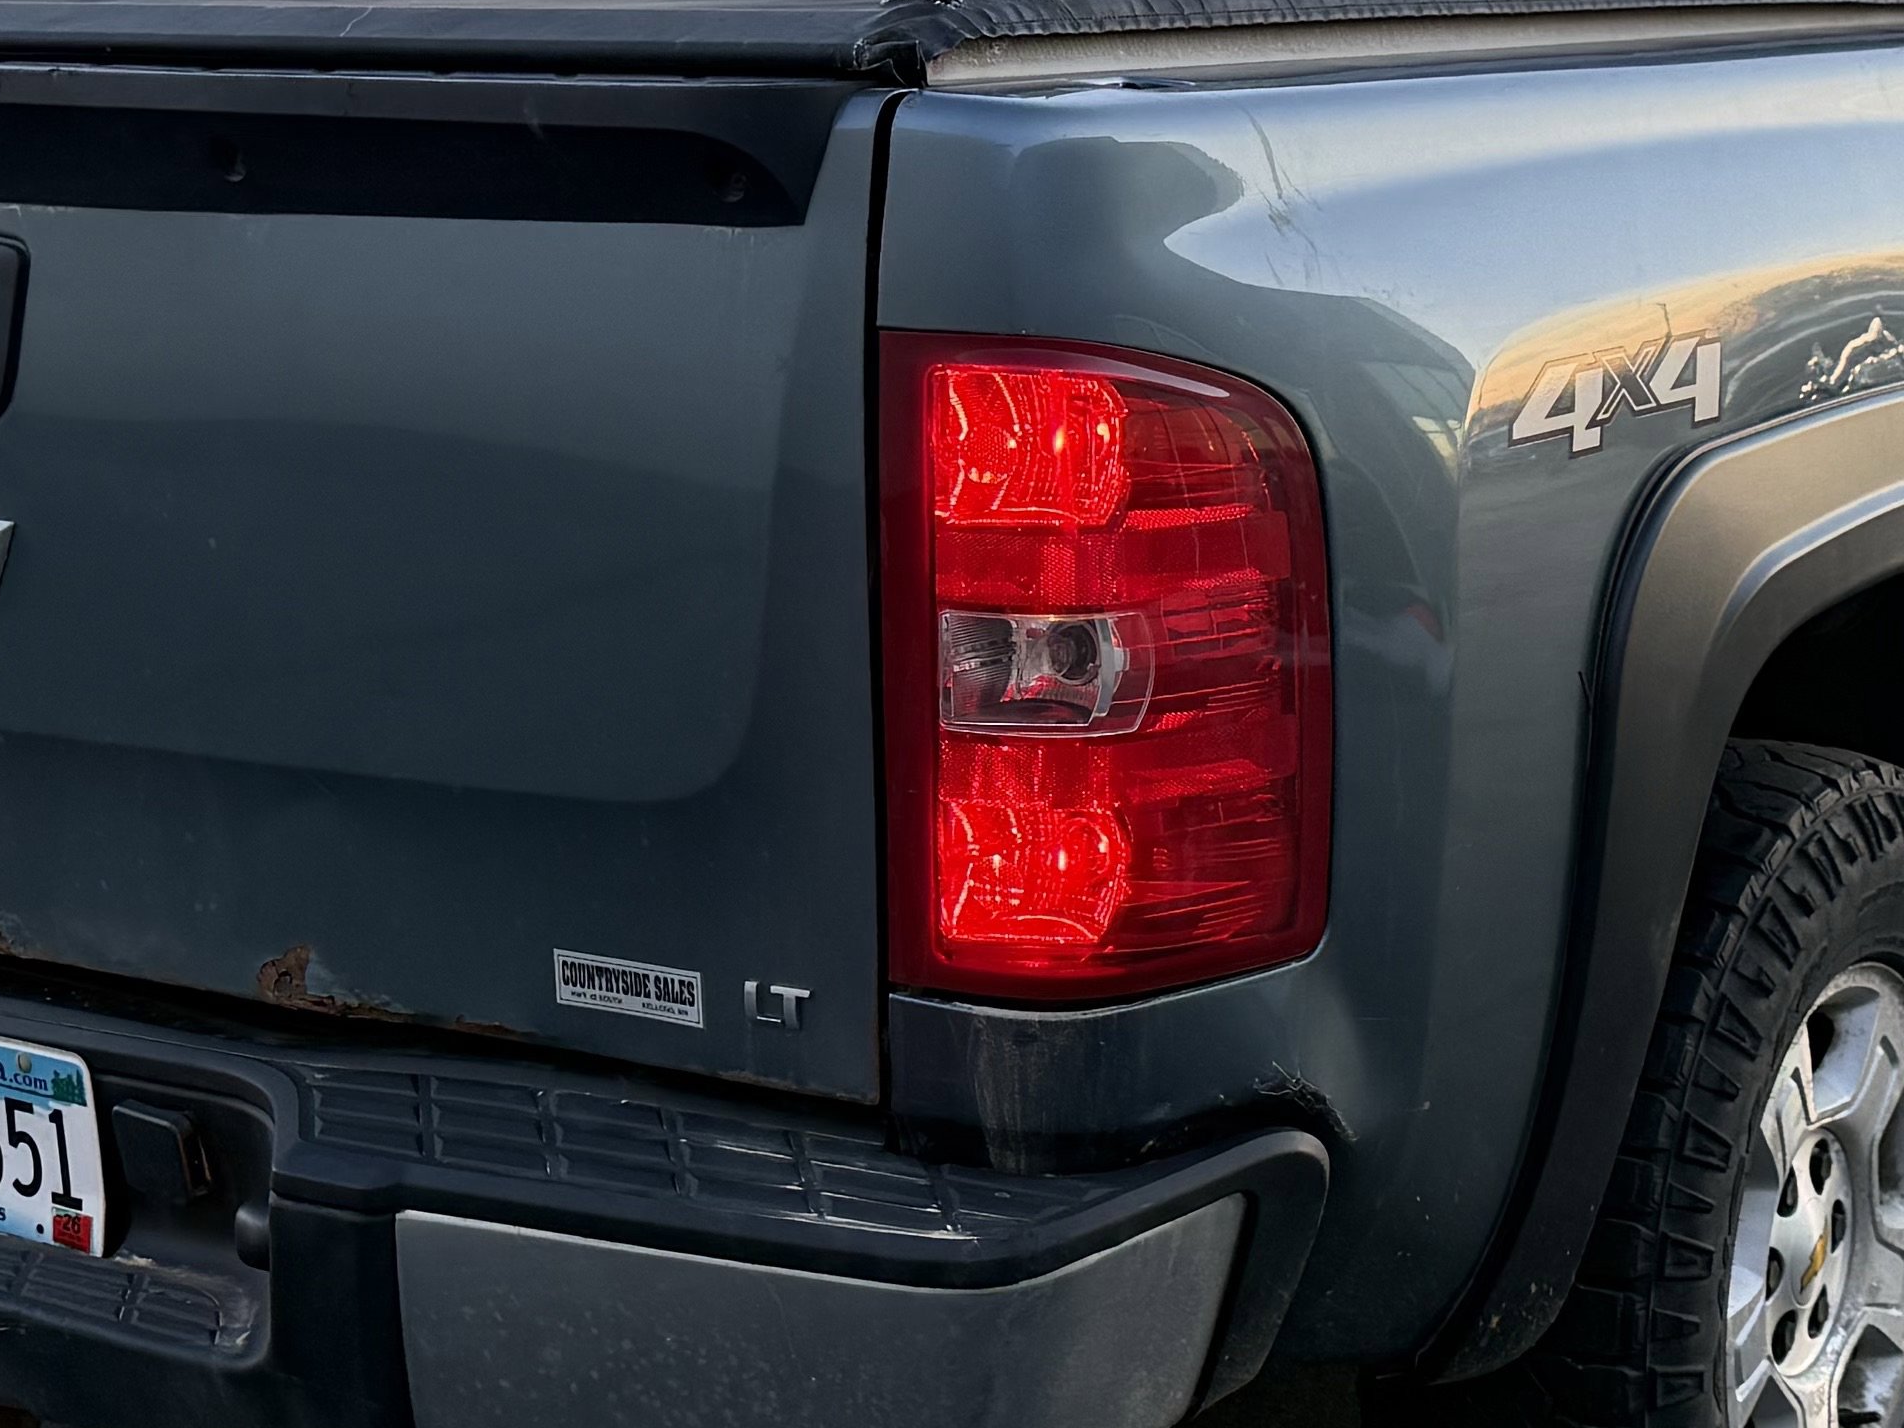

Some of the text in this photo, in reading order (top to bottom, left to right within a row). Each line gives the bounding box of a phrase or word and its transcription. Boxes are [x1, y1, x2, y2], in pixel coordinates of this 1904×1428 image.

[561, 959, 696, 1008] COUNTRYSIDE SALES
[743, 978, 812, 1030] LT
